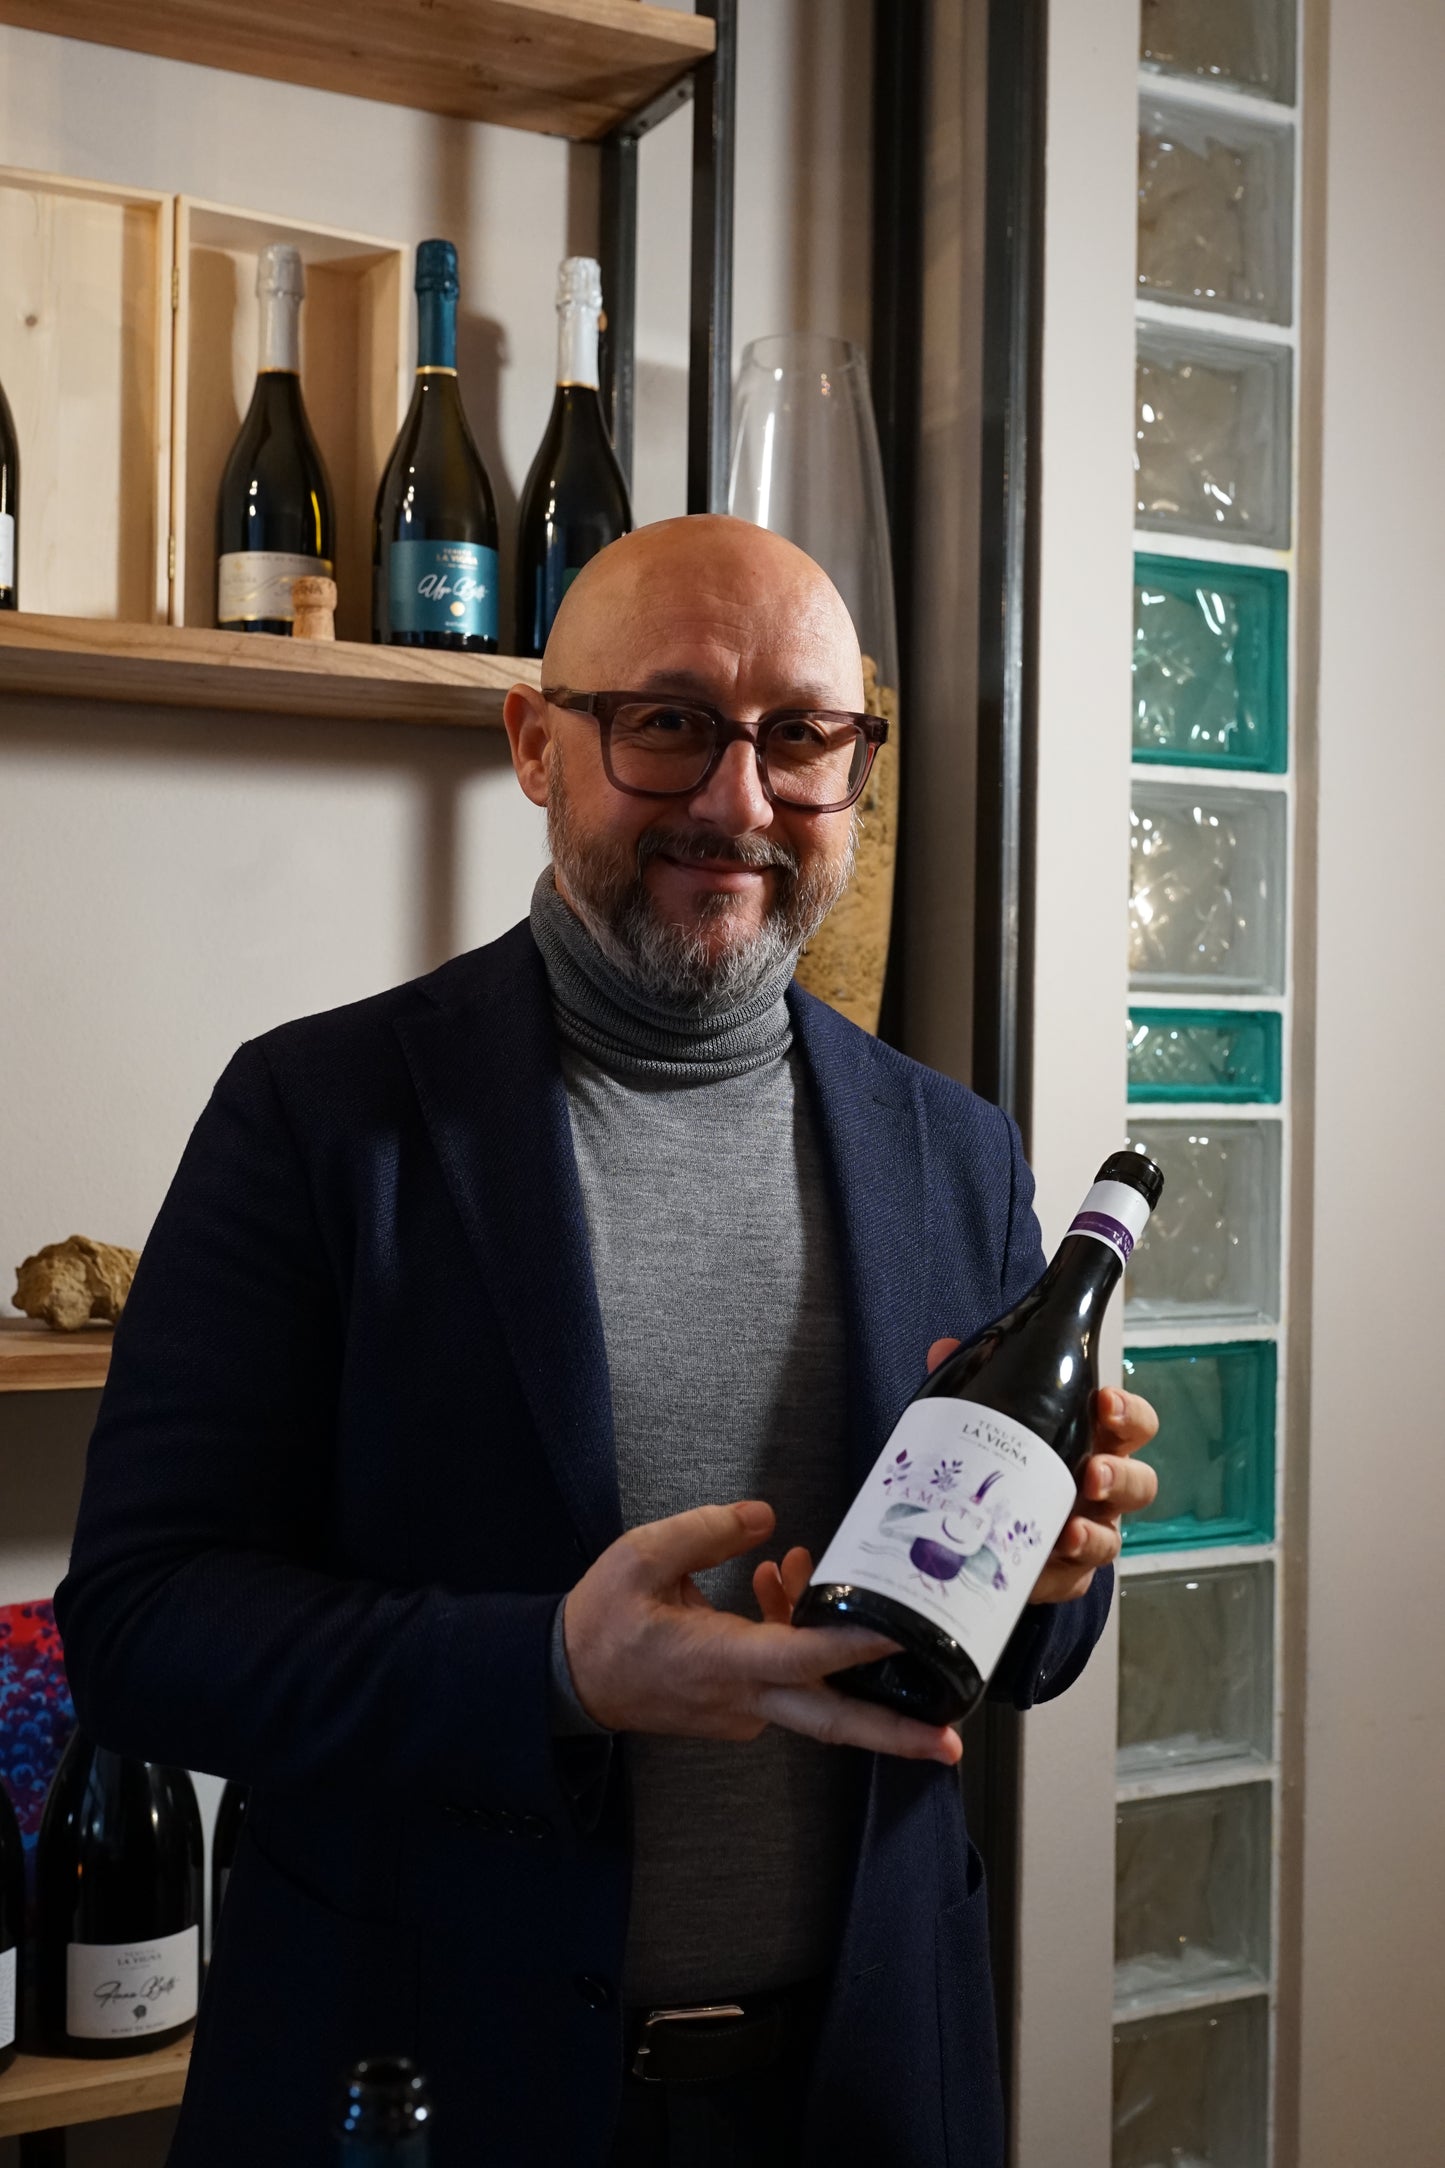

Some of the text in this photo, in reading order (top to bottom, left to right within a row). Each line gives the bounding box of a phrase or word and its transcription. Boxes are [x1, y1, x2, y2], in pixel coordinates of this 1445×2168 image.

[962, 1423, 980, 1439] LA
[986, 1432, 1028, 1467] VIGNA
[979, 1419, 1024, 1449] TENUTA
